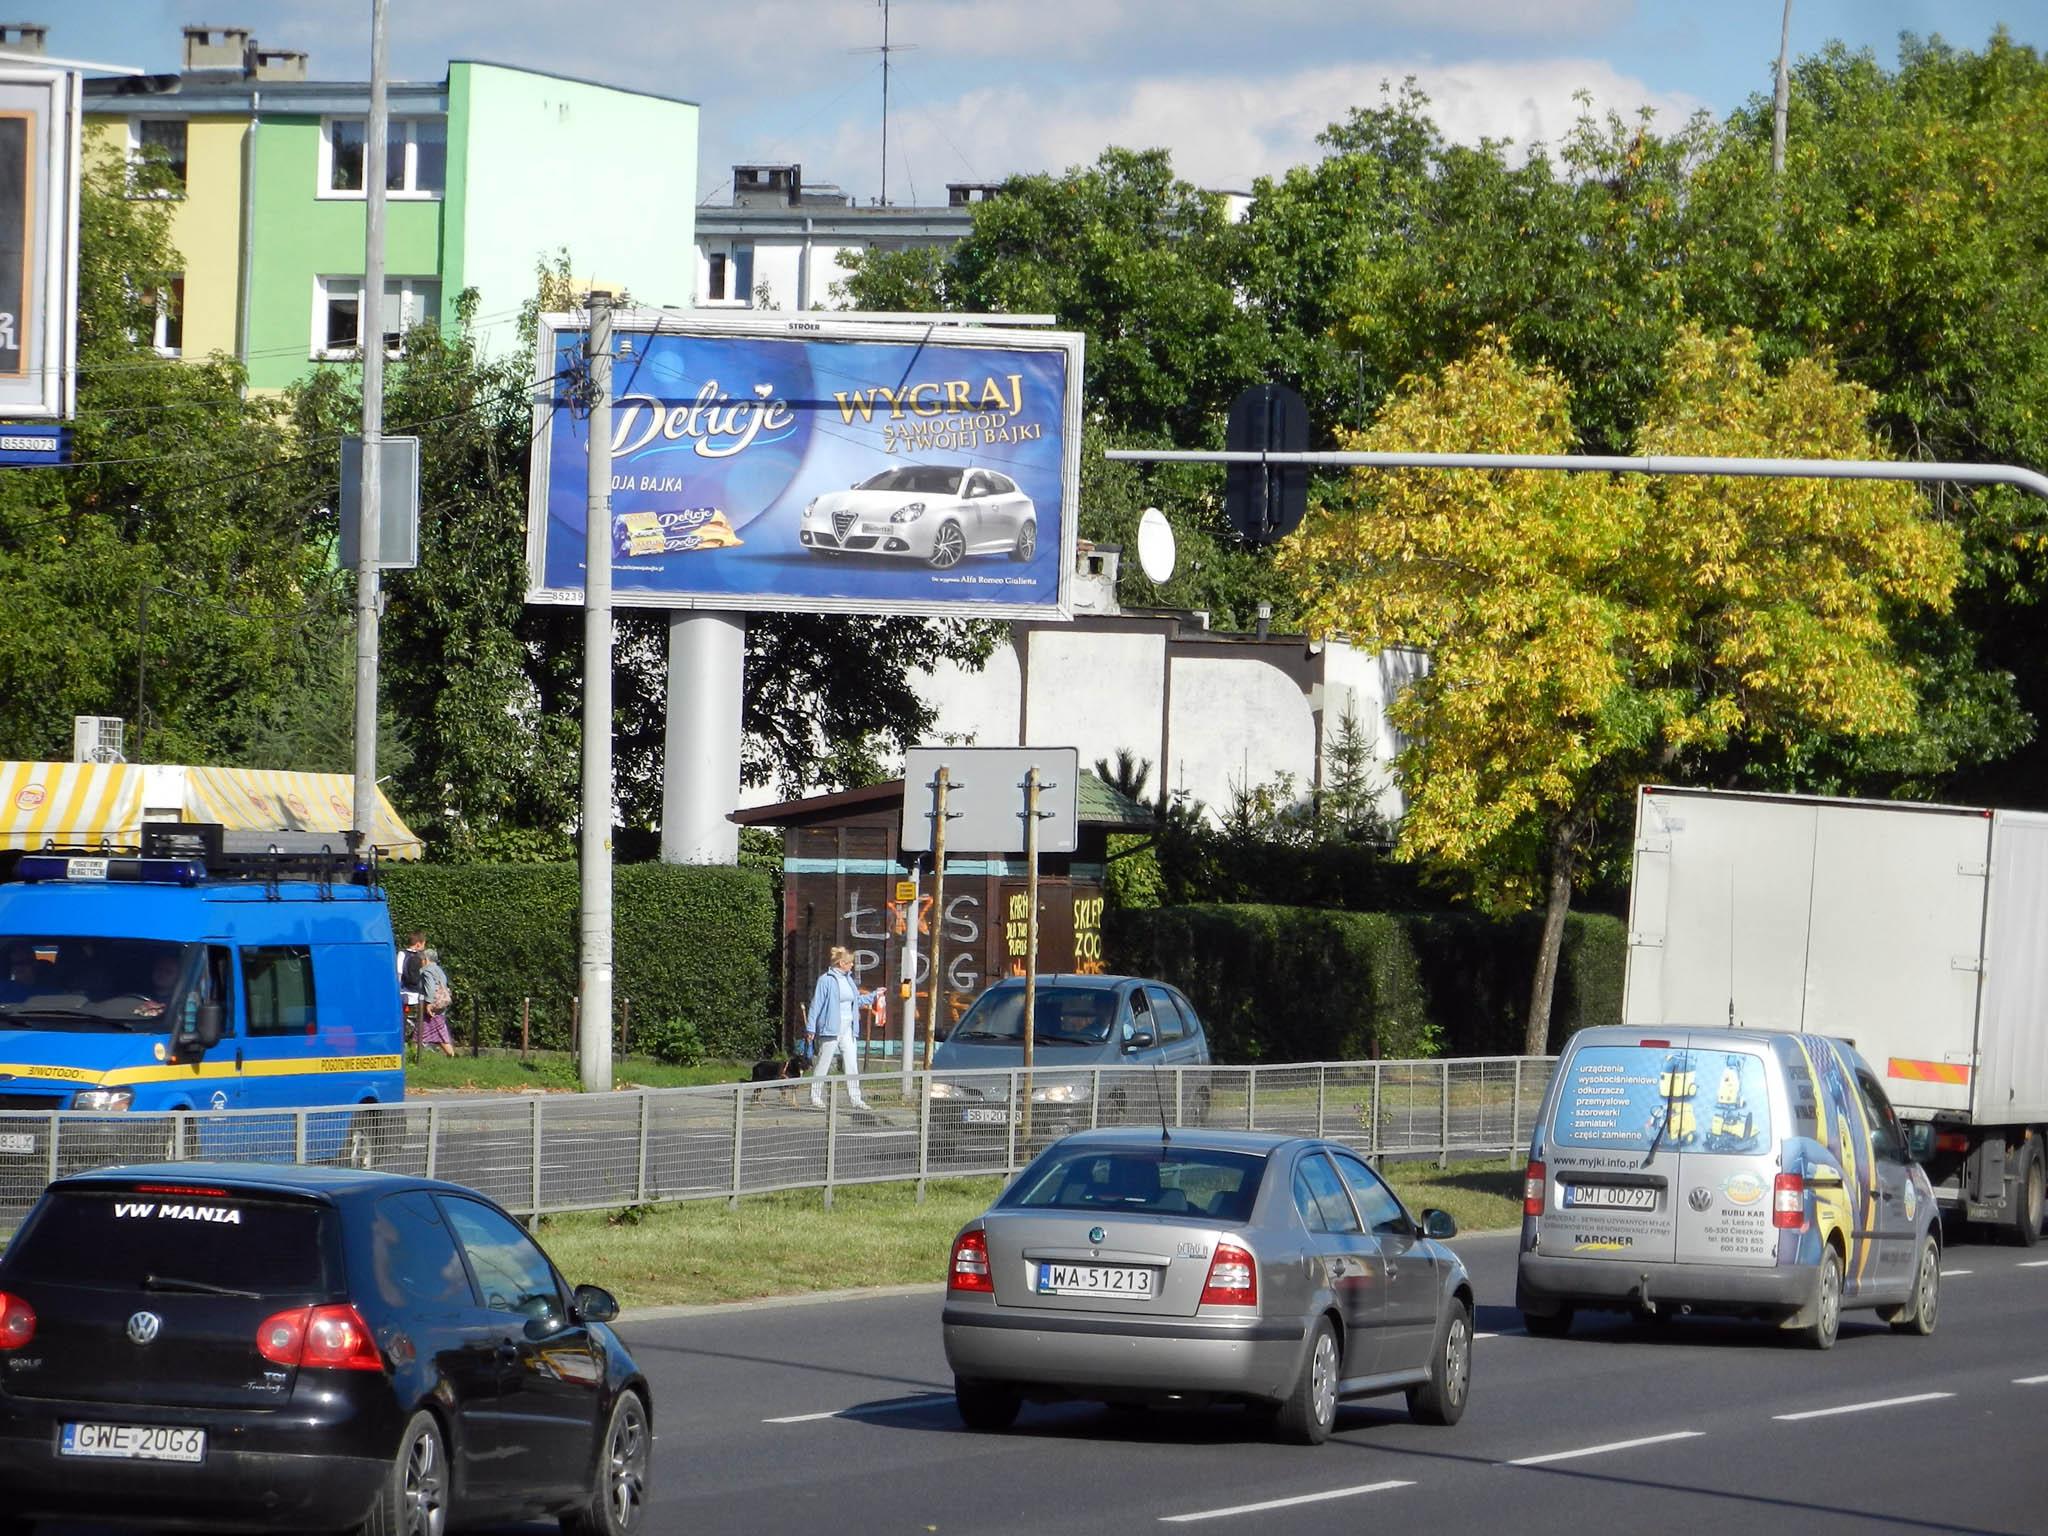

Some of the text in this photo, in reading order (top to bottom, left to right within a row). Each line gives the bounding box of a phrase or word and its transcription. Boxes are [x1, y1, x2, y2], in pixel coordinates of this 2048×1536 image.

[833, 374, 1023, 425] WYGRAJ
[586, 378, 795, 459] Delicje
[883, 411, 1007, 438] SAMOCHÓD
[3, 438, 55, 451] 8553073
[885, 422, 1042, 454] Z TWOJEJ BAJKI
[611, 475, 683, 492] OJA BAJKA
[658, 508, 714, 528] Delicje
[960, 575, 977, 584] Alfa
[978, 577, 1004, 585] Romeo
[552, 591, 584, 601] 85239
[1074, 897, 1104, 930] SKLEP
[1074, 932, 1103, 960] ZOO
[1580, 1064, 1625, 1075] urządzenia
[1578, 1074, 1659, 1085] wysokociśnieniowe
[1577, 1086, 1625, 1095] odkurzacze
[1576, 1098, 1631, 1107] przemysłowe
[1575, 1108, 1621, 1117] szorowarki
[1574, 1119, 1618, 1128] zamiatarki
[1574, 1131, 1643, 1140] części zamienne
[1553, 1157, 1639, 1170] www.myjki.info.pl
[1607, 1189, 1654, 1206] 00797
[114, 1203, 241, 1225] VW MANIA
[1721, 1209, 1746, 1217] BUBU
[1053, 1267, 1149, 1291] WA 51213
[79, 1424, 199, 1453] GWE 20G6
